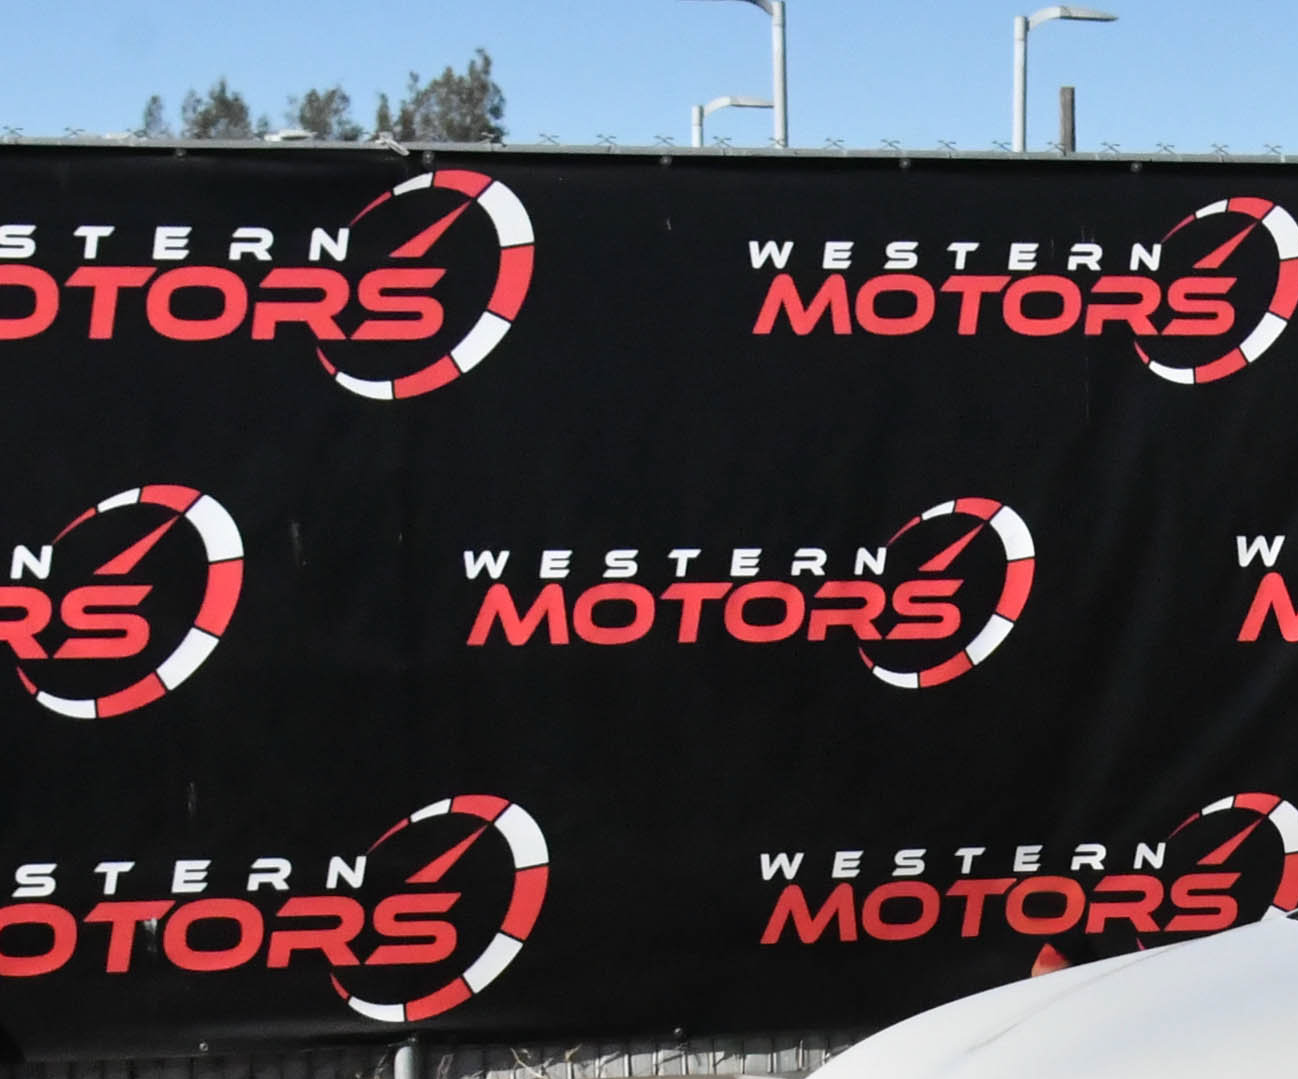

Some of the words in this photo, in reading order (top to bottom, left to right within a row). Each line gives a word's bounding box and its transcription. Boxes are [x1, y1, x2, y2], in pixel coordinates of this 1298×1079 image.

[749, 241, 1161, 271] WESTERN
[753, 274, 1237, 336] MOTORS
[464, 547, 886, 579] WESTERN
[467, 580, 963, 645] MOTORS
[761, 843, 1165, 880] WESTERN
[761, 873, 1238, 944] MOTORS
